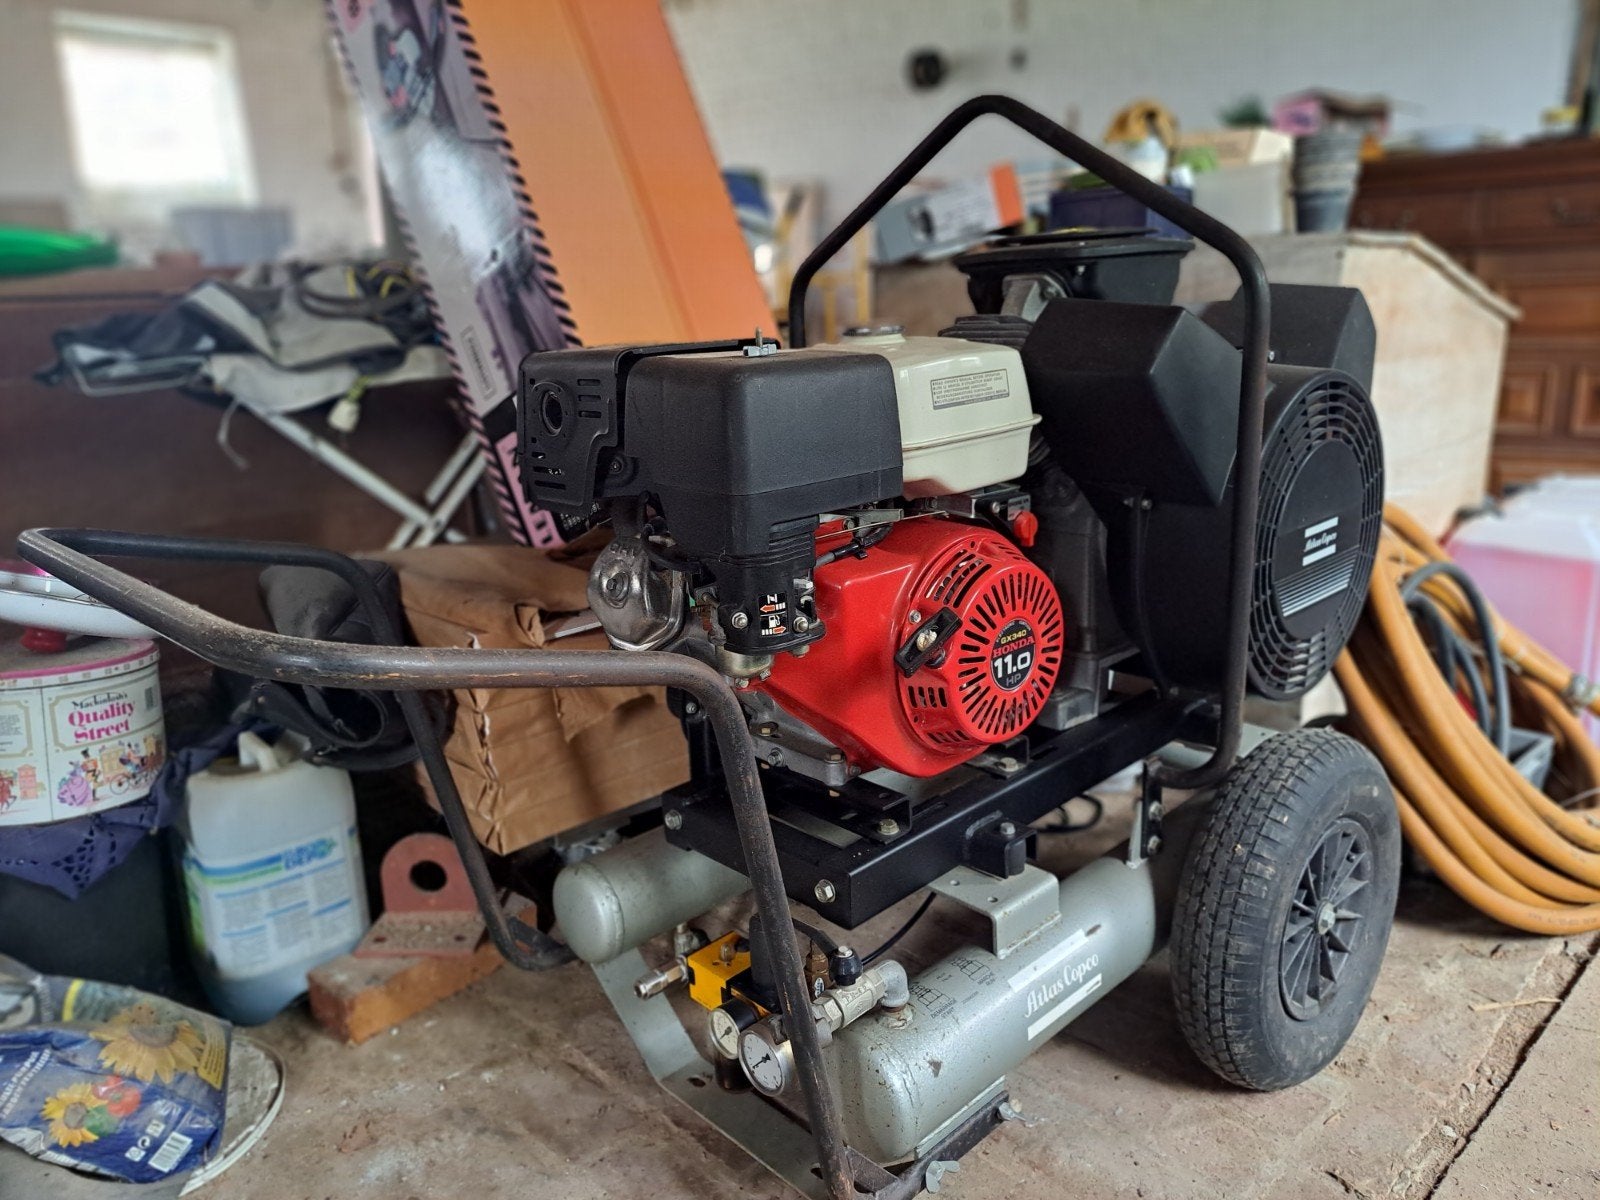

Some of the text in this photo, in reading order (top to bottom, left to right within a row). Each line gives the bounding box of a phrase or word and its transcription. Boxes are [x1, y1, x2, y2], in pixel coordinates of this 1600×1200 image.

[993, 636, 1034, 658] HONDA
[1001, 629, 1026, 644] GX340
[994, 651, 1030, 678] 11.0
[1006, 673, 1021, 686] HP
[68, 701, 134, 727] Quality
[74, 719, 129, 742] Street
[1024, 954, 1099, 1018] Atlas Copco
